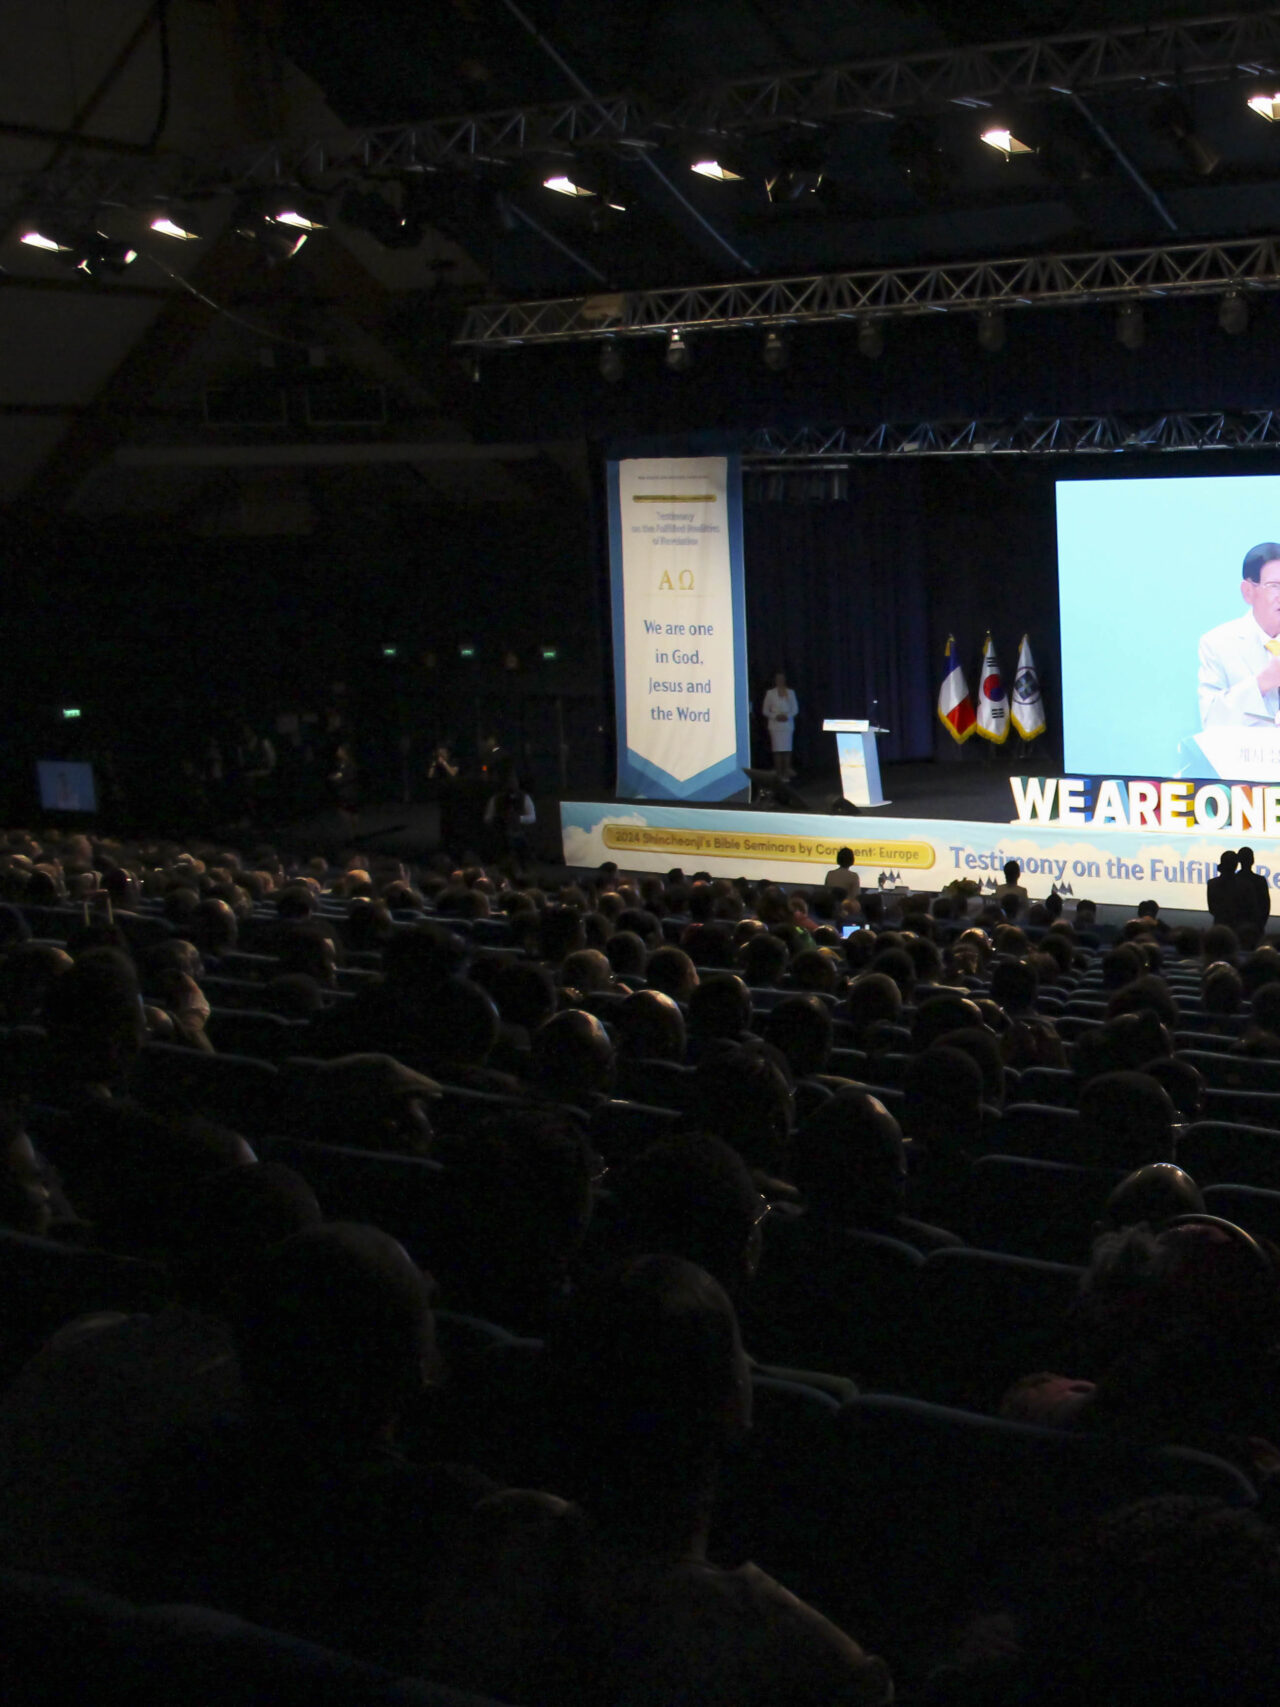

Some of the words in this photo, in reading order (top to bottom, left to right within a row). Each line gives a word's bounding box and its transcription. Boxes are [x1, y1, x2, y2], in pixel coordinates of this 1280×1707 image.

[644, 620, 662, 635] We
[665, 623, 685, 635] are
[688, 624, 714, 636] one
[656, 648, 668, 664] in
[648, 677, 683, 694] Jesus
[686, 680, 711, 694] and
[651, 706, 673, 720] the
[676, 707, 710, 722] Word
[1009, 776, 1091, 823] WE
[1092, 779, 1194, 827] ARE
[616, 832, 640, 842] 2024
[643, 832, 711, 850] Shincheonji's
[714, 838, 740, 850] Bible
[744, 840, 795, 854] Seminars
[800, 843, 813, 856] by
[879, 847, 920, 860] Europe
[1072, 860, 1100, 878] on
[1106, 857, 1144, 880] the
